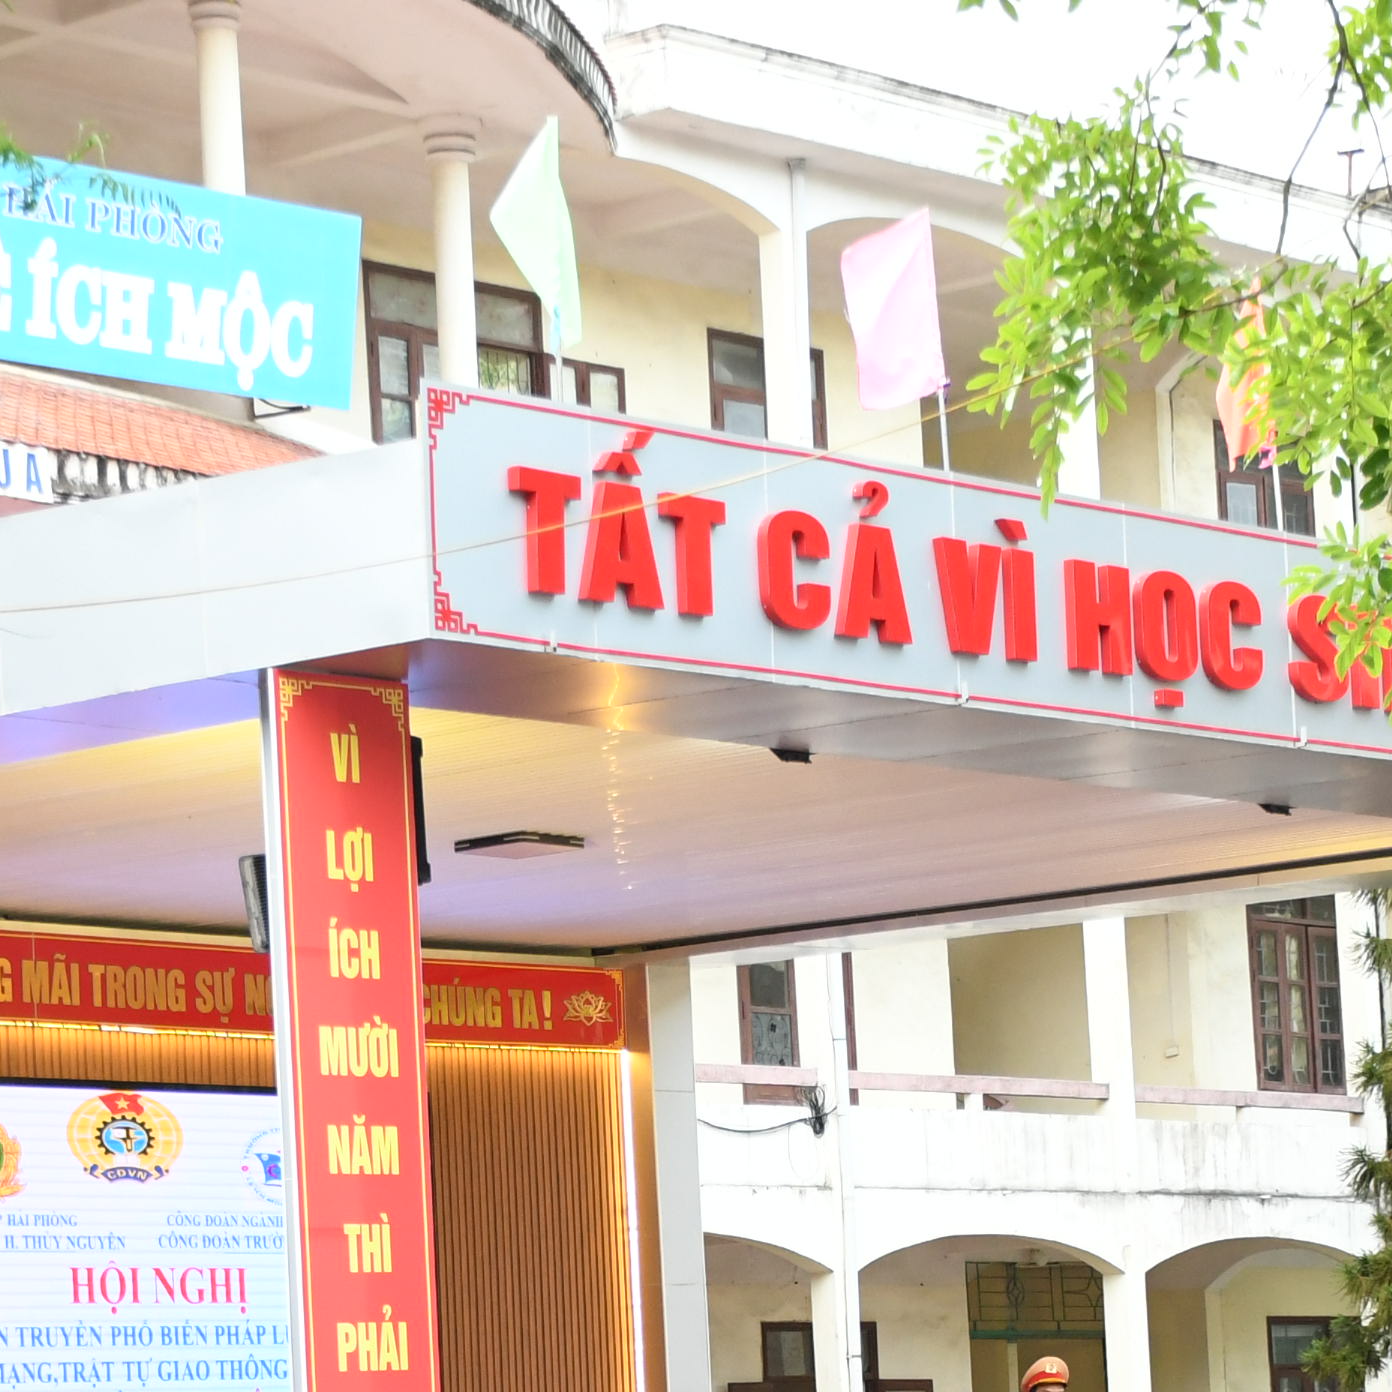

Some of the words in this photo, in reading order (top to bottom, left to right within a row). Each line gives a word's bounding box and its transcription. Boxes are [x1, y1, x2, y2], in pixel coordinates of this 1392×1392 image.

[85, 198, 224, 254] PHÒNG
[27, 237, 155, 354] ÍCH
[165, 270, 314, 391] MỘC
[26, 452, 44, 494] A
[508, 428, 726, 618] TẤT
[757, 481, 912, 645] CẢ
[932, 518, 1038, 662] VÌ
[1064, 558, 1264, 708] HỌC
[330, 723, 361, 784] VÌ
[325, 825, 375, 892] LỢI
[328, 917, 381, 980] ÍCH
[21, 953, 80, 1007] MÃI
[88, 964, 186, 1013] TRONG
[195, 967, 235, 1024] SỰ
[319, 1015, 399, 1079] MƯỜI
[327, 1115, 400, 1177] NĂM
[66, 1232, 126, 1250] NGUYÊN
[158, 1231, 198, 1249] CÔNG
[202, 1232, 241, 1249] ĐOÀN
[167, 1210, 201, 1227] CÔNG
[343, 1220, 393, 1273] THÌ
[69, 1260, 142, 1315] HỘI
[152, 1266, 248, 1315] NGHỊ
[16, 1319, 103, 1347] TRUYỀN
[160, 1319, 208, 1346] BIẾN
[214, 1318, 266, 1346] PHÁP
[337, 1304, 409, 1373] PHẢI
[122, 1357, 153, 1388] TỰ
[157, 1360, 210, 1382] GIAO
[215, 1353, 288, 1381] THÔNG
